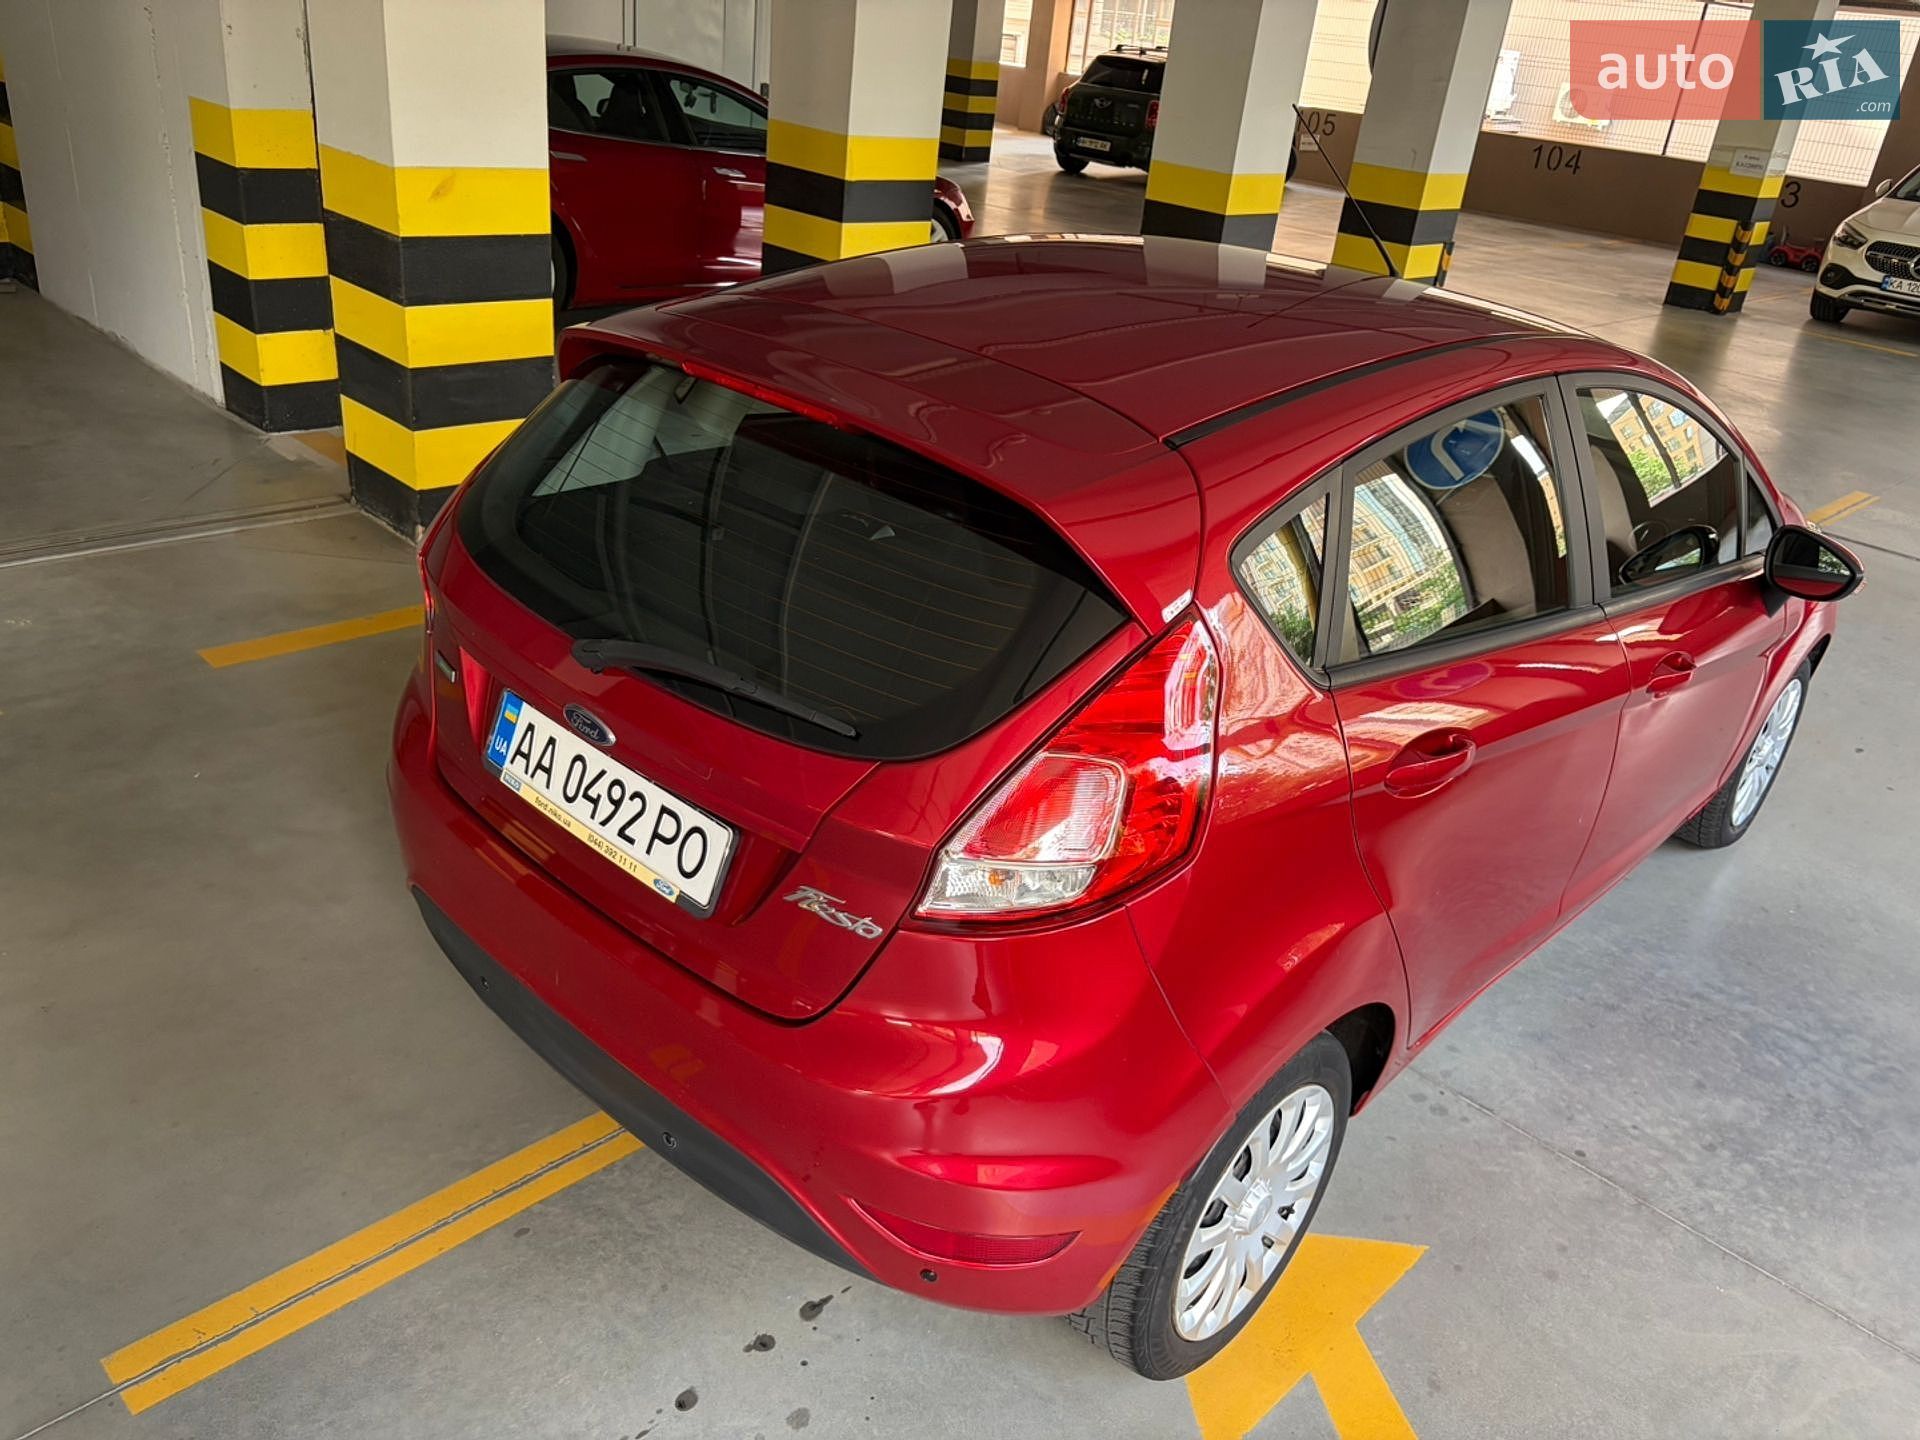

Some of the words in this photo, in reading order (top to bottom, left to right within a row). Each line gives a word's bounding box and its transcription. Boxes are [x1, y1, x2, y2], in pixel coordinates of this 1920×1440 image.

[1533, 144, 1582, 175] 104
[571, 711, 601, 740] Ford
[495, 734, 508, 756] UA
[510, 722, 557, 790] AA
[562, 753, 648, 846] 0492
[645, 804, 708, 879] PO
[783, 885, 883, 939] Fiesta
